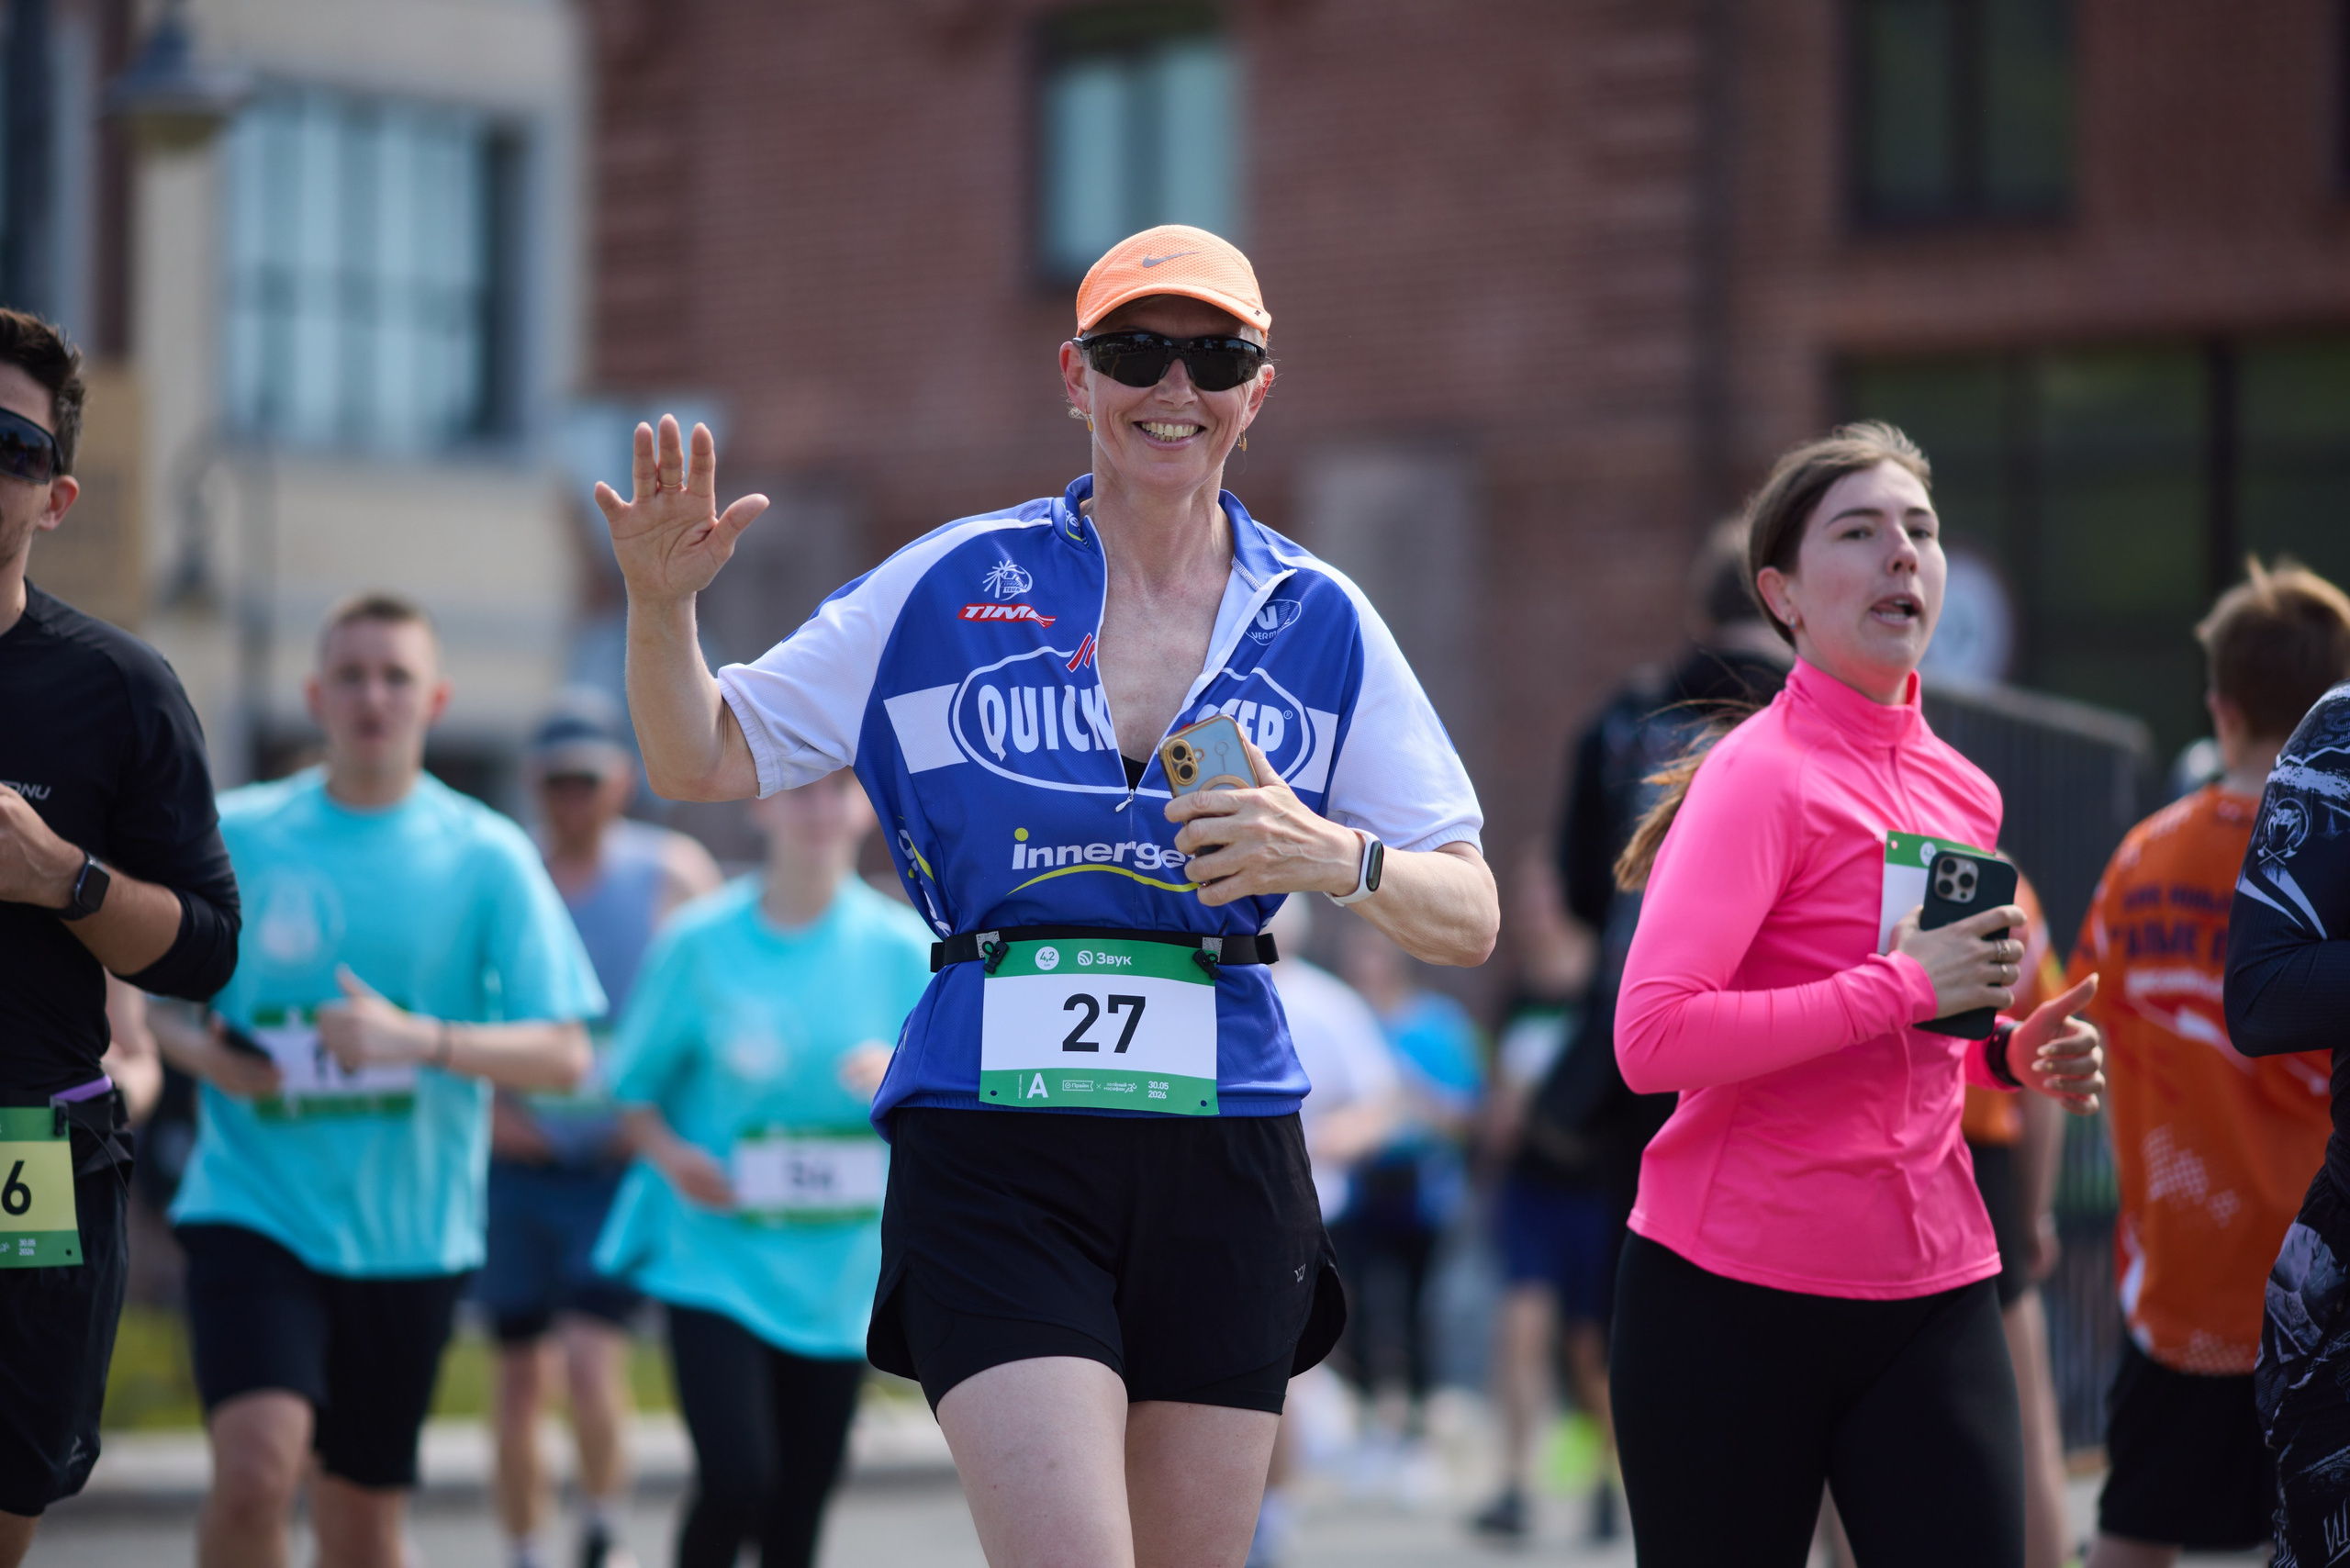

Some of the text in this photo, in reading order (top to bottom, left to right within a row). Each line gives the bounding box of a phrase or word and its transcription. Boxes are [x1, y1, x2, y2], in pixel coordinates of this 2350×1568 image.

[978, 684, 1118, 762] QUICK
[1012, 827, 1196, 869] innerge
[1039, 951, 1055, 963] 4,2
[1096, 952, 1132, 967] Звук
[1062, 993, 1147, 1054] 27
[1026, 1072, 1049, 1099] A
[1147, 1081, 1169, 1090] 30.05
[1147, 1090, 1167, 1099] 2026
[1, 1159, 32, 1216] 6
